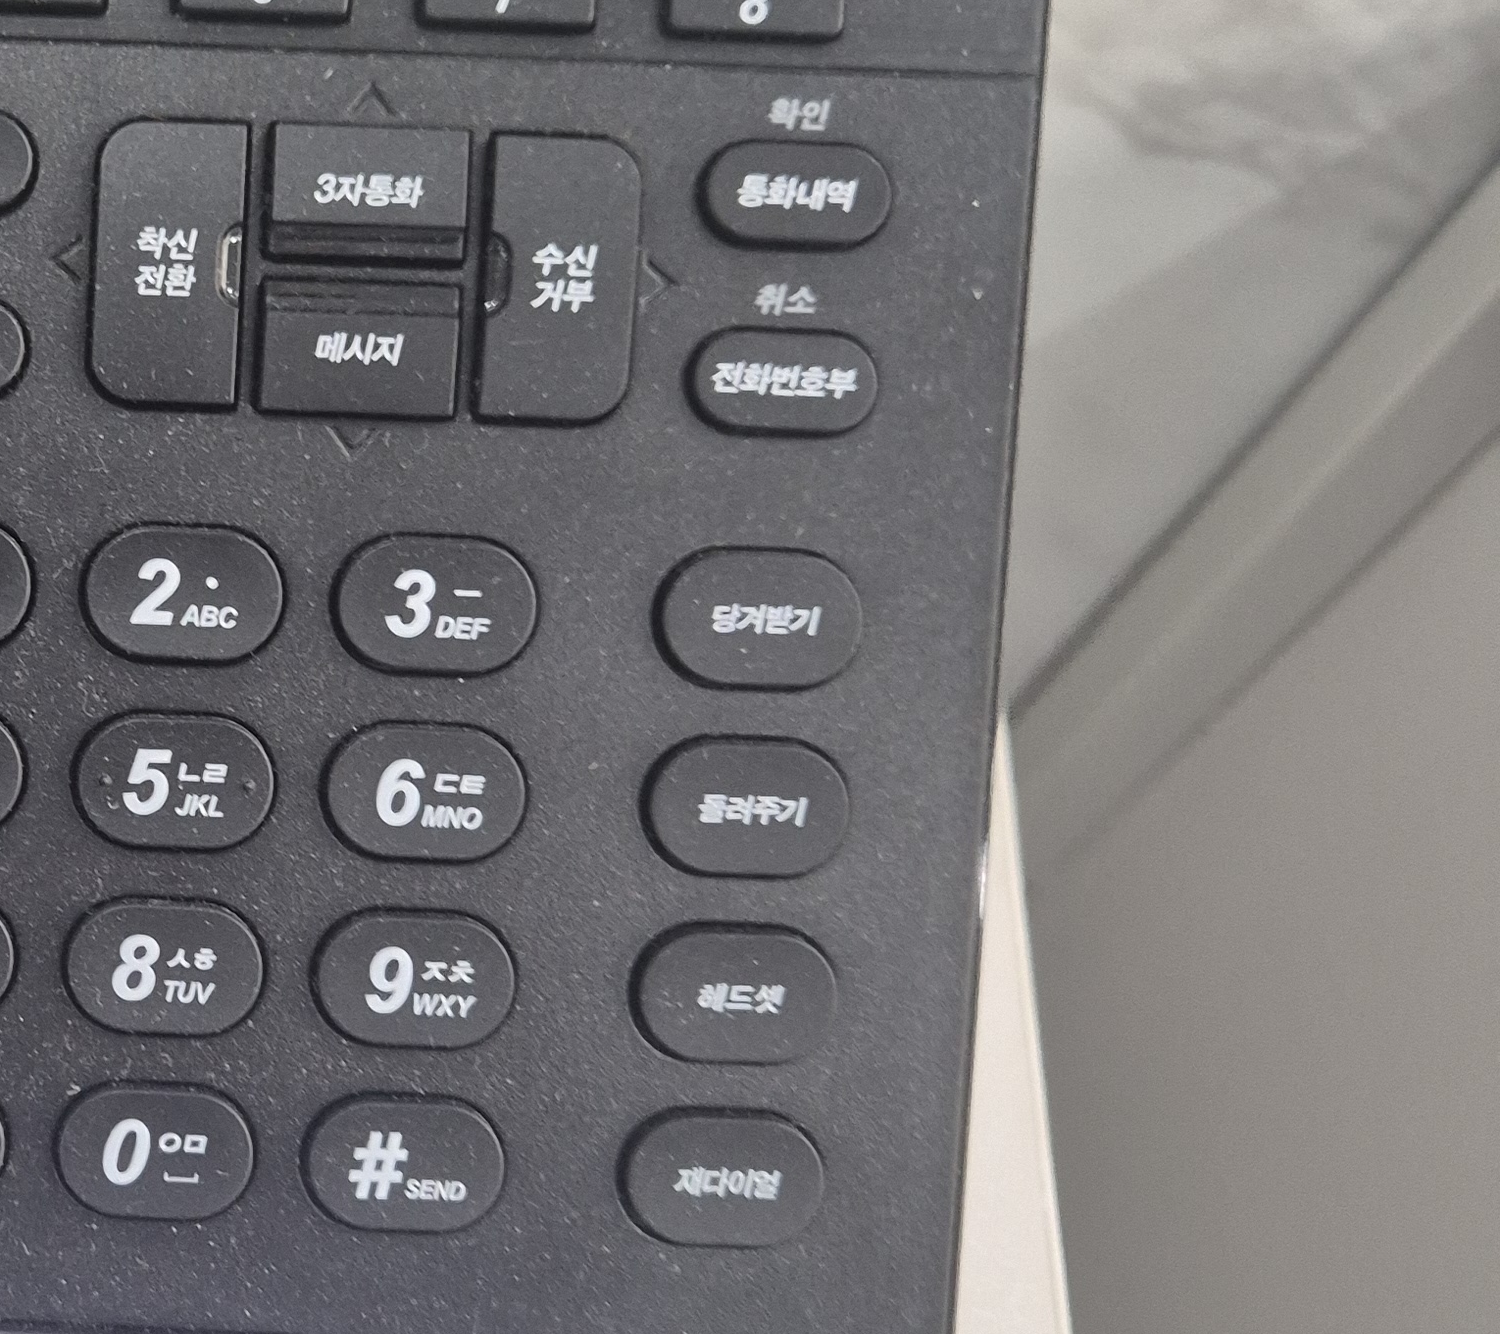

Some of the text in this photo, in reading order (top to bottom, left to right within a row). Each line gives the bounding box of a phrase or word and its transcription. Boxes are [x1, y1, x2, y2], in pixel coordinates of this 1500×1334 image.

[768, 98, 830, 130] 확인
[314, 173, 423, 208] 3자통화
[737, 175, 858, 213] 통화내역
[137, 227, 198, 260] 착신
[532, 244, 598, 277] 수신
[135, 264, 196, 296] 전환
[530, 279, 594, 313] 거부
[755, 284, 816, 316] 취소
[315, 332, 404, 366] 메시지
[712, 362, 857, 399] 전화번호부
[130, 558, 181, 626] 2
[385, 569, 436, 638] 3
[180, 605, 238, 628] ABC
[435, 616, 491, 640] DEF
[712, 603, 821, 635] 당겨받기
[123, 749, 172, 815] 5
[376, 759, 425, 827] 6
[175, 794, 223, 817] JKL
[421, 805, 483, 830] MNO
[698, 794, 808, 827] 돌려주기
[112, 934, 160, 1001] 8
[365, 947, 414, 1014] 9
[164, 980, 215, 1004] TUV
[413, 993, 476, 1017] WXY
[697, 983, 785, 1013] 헤드셋
[103, 1119, 150, 1185] 0
[404, 1179, 466, 1201] SEND
[673, 1166, 781, 1199] 재다이얼
